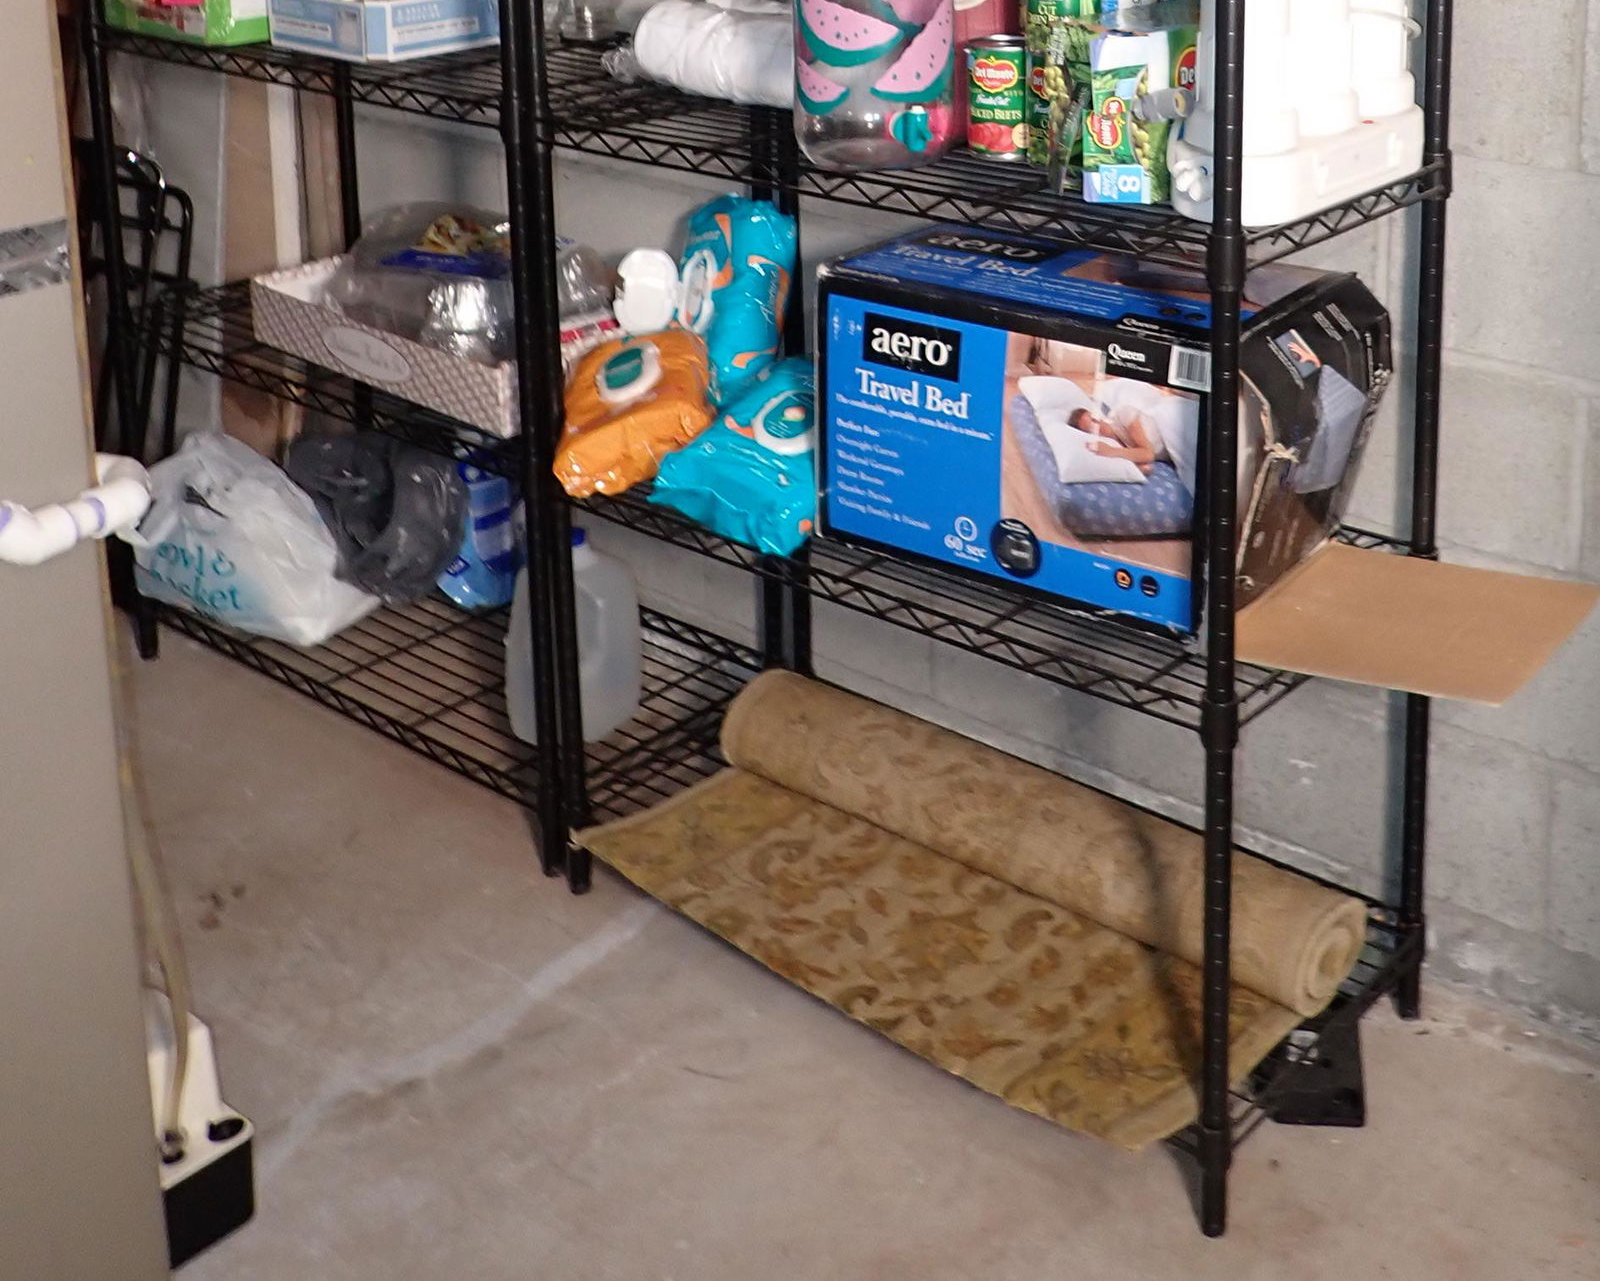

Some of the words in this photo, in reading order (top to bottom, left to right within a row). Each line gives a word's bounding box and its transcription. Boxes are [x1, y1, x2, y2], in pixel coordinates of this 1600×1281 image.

[975, 68, 987, 79] Del
[987, 68, 1014, 81] Monte
[1180, 67, 1195, 85] De
[994, 108, 1023, 120] BEETS
[1117, 174, 1141, 193] 8
[927, 234, 1039, 259] aero
[892, 245, 977, 266] Travel
[977, 259, 1039, 277] Bed
[871, 327, 951, 366] aero
[1107, 343, 1146, 363] Queen
[855, 367, 920, 408] Travel
[924, 385, 971, 419] Bed
